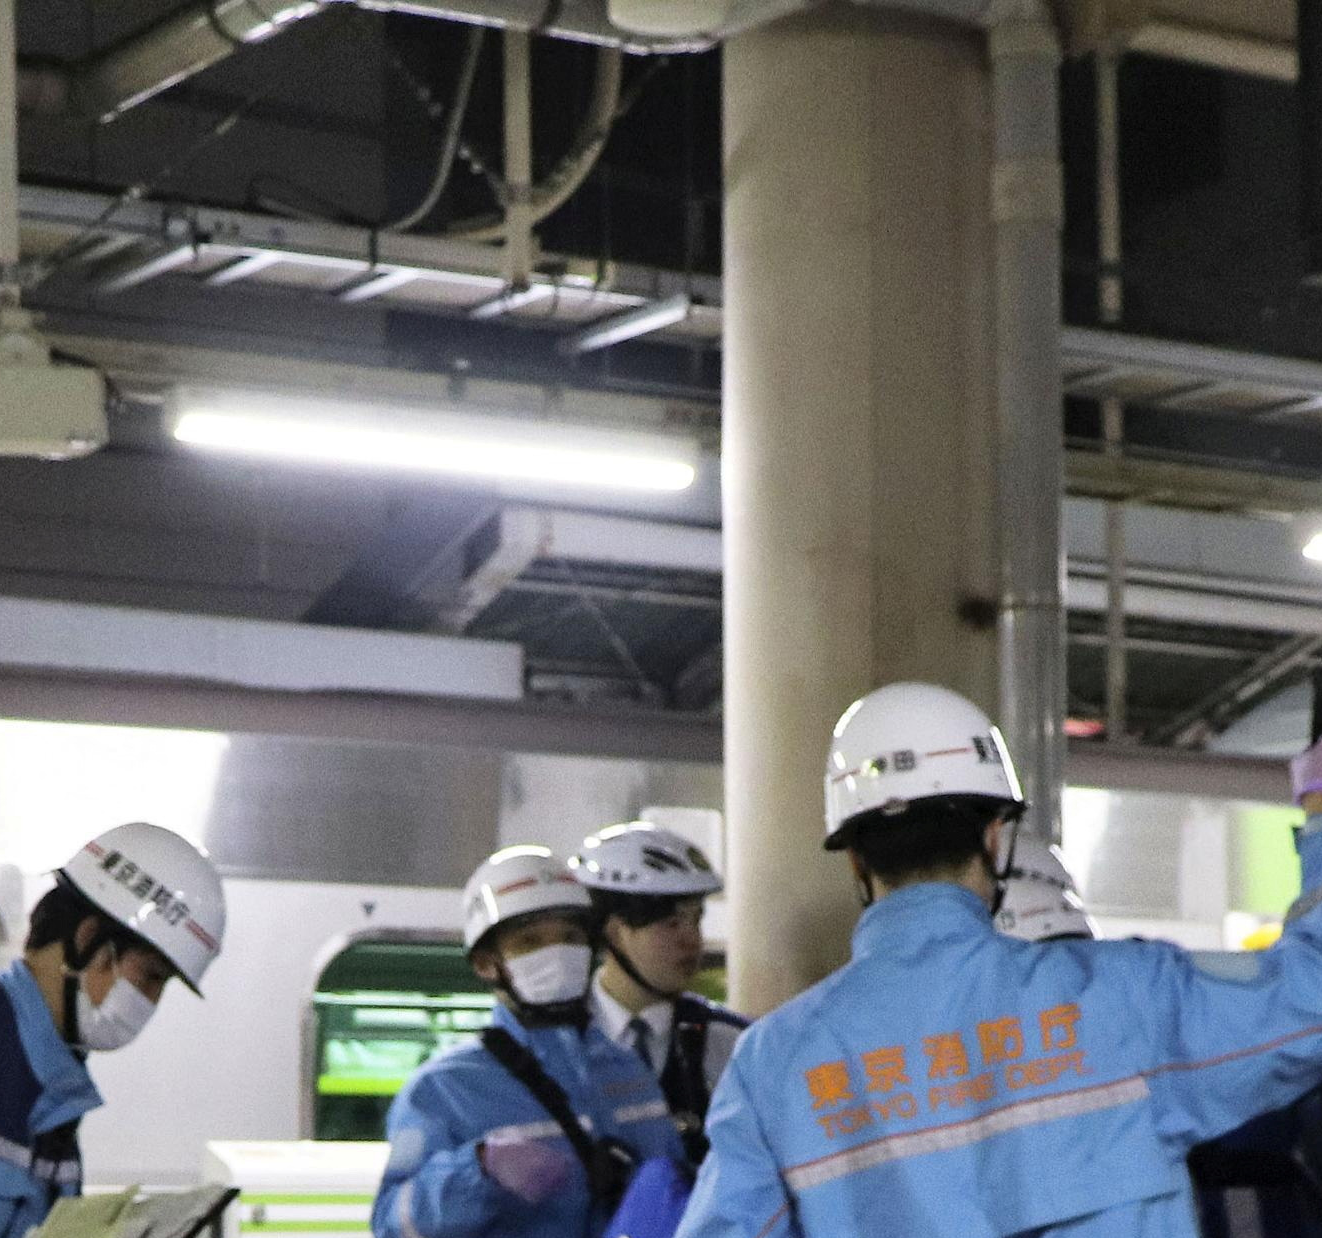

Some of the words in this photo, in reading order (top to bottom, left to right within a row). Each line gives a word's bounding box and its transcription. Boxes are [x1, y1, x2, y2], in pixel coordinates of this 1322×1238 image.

[805, 1003, 1082, 1110] 東京消防庁
[816, 1092, 918, 1139] TOKYO
